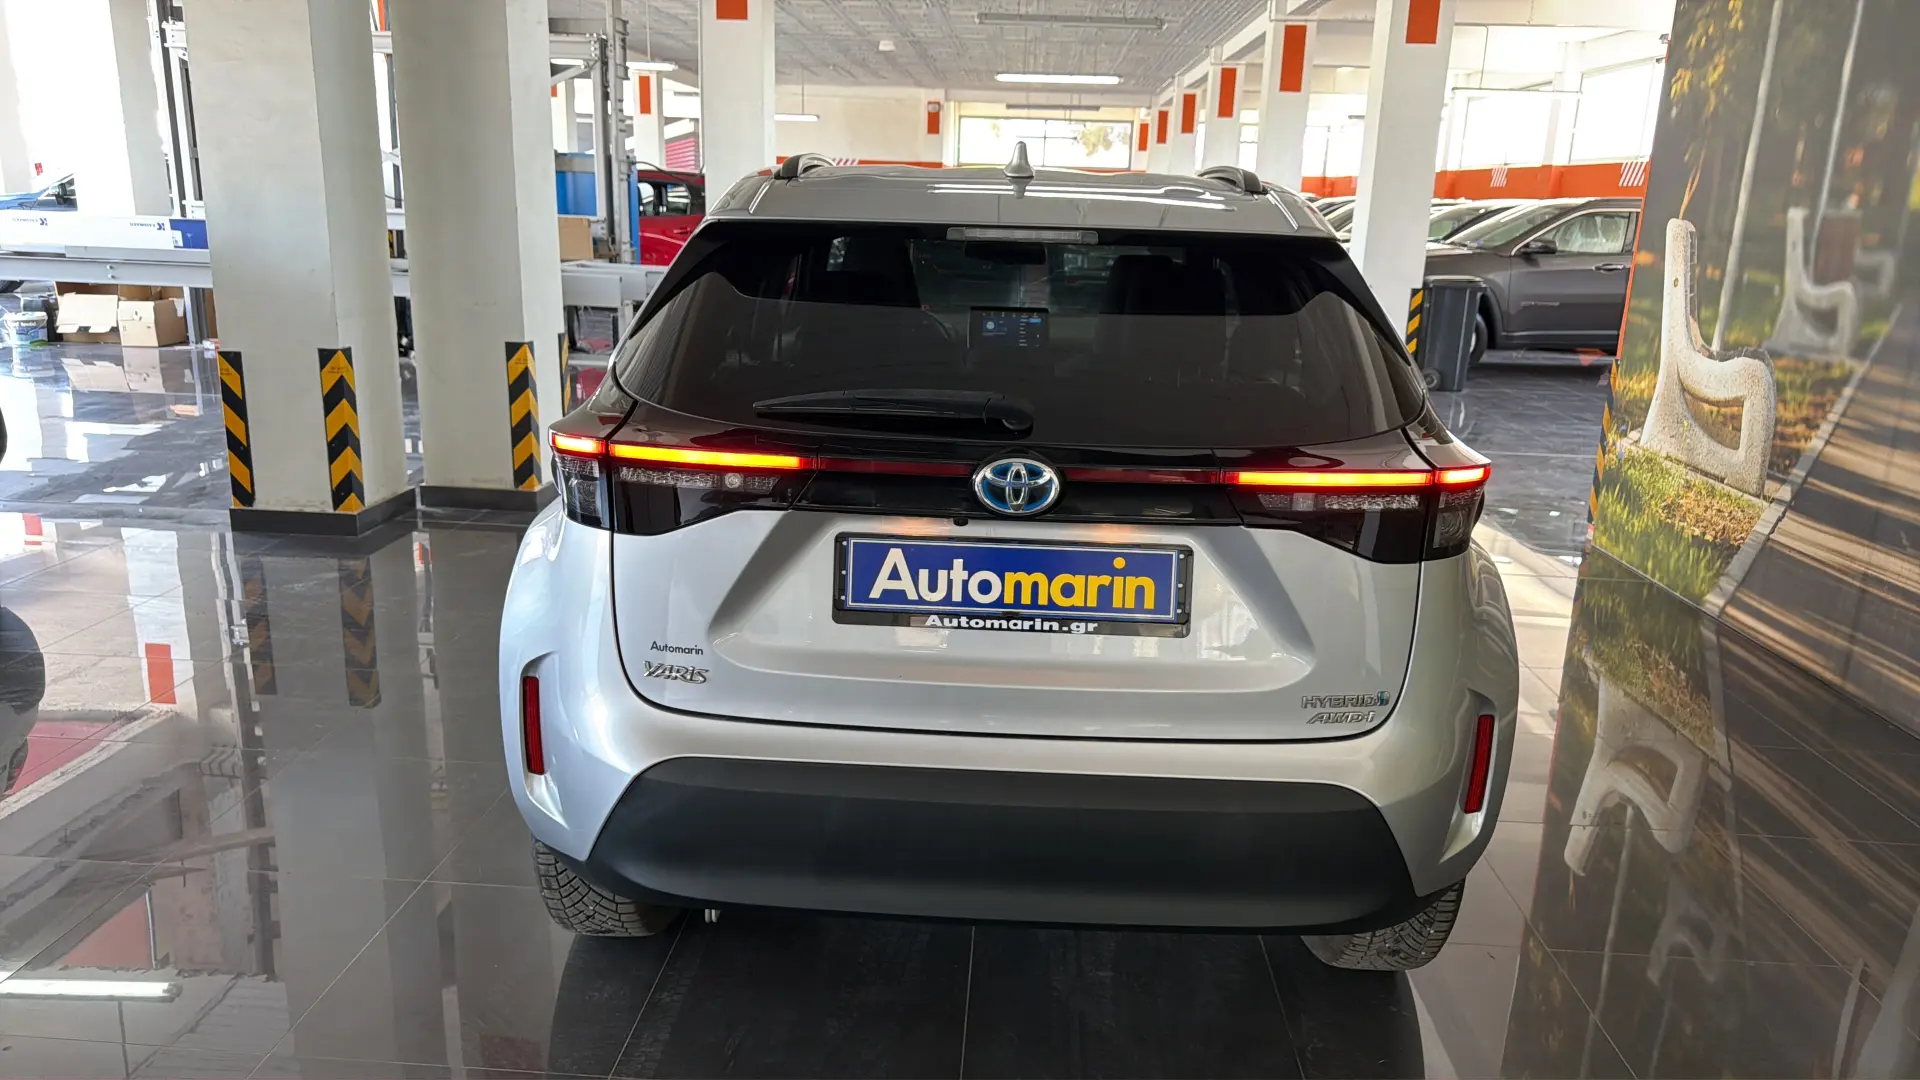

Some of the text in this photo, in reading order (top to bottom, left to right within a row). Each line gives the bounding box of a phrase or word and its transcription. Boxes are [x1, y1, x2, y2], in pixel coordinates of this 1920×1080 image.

[868, 547, 1156, 610] Automarin
[924, 614, 1098, 634] Automarin.gr
[650, 640, 704, 656] Automarin
[1301, 694, 1378, 709] HYBRID
